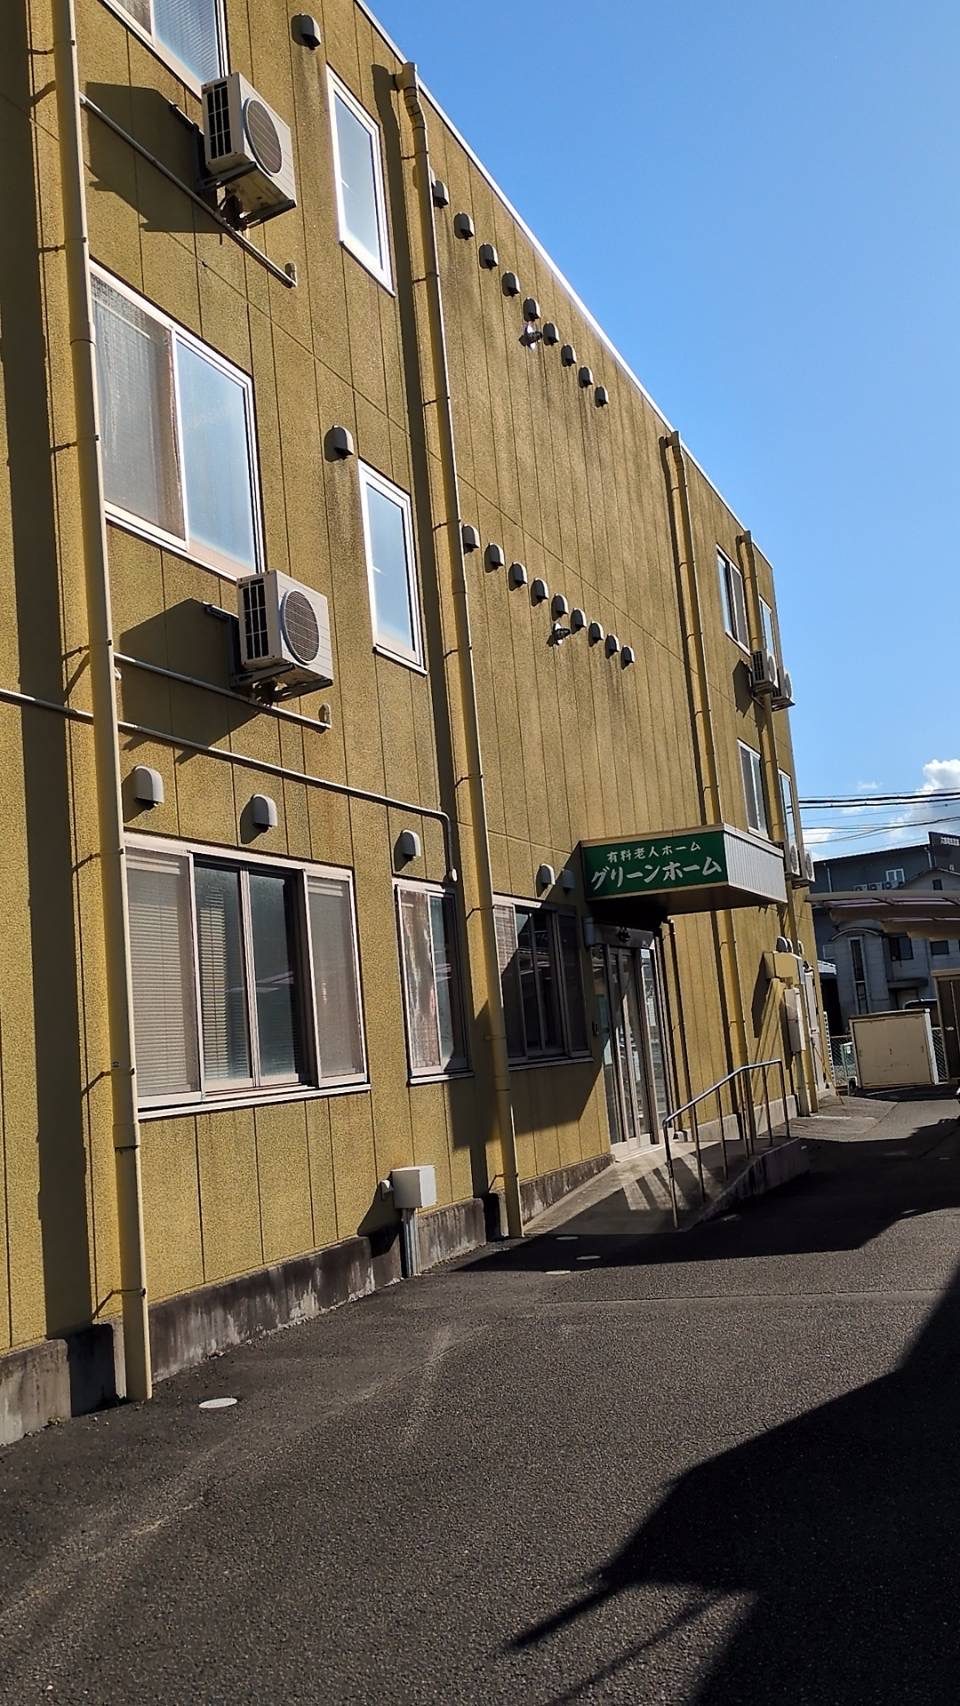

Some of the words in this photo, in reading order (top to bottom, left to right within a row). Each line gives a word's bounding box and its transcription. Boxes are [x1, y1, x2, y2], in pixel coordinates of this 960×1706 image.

[606, 842, 701, 863] 有料老人ホーム
[591, 857, 722, 890] グリーンホーム
